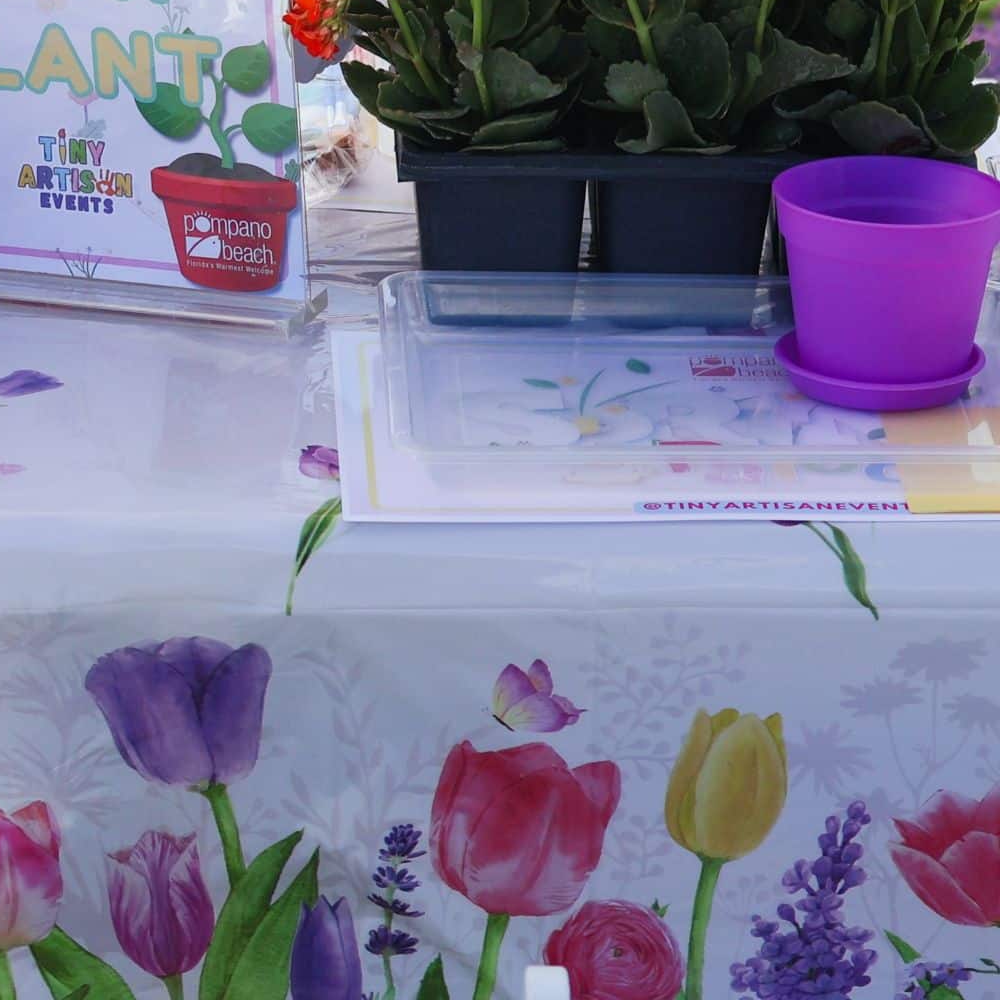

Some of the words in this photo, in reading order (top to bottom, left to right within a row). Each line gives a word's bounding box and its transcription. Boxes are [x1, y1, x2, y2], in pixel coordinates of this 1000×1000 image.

[40, 192, 114, 214] EVENTS
[184, 210, 272, 239] pompano
[222, 240, 273, 264] beach
